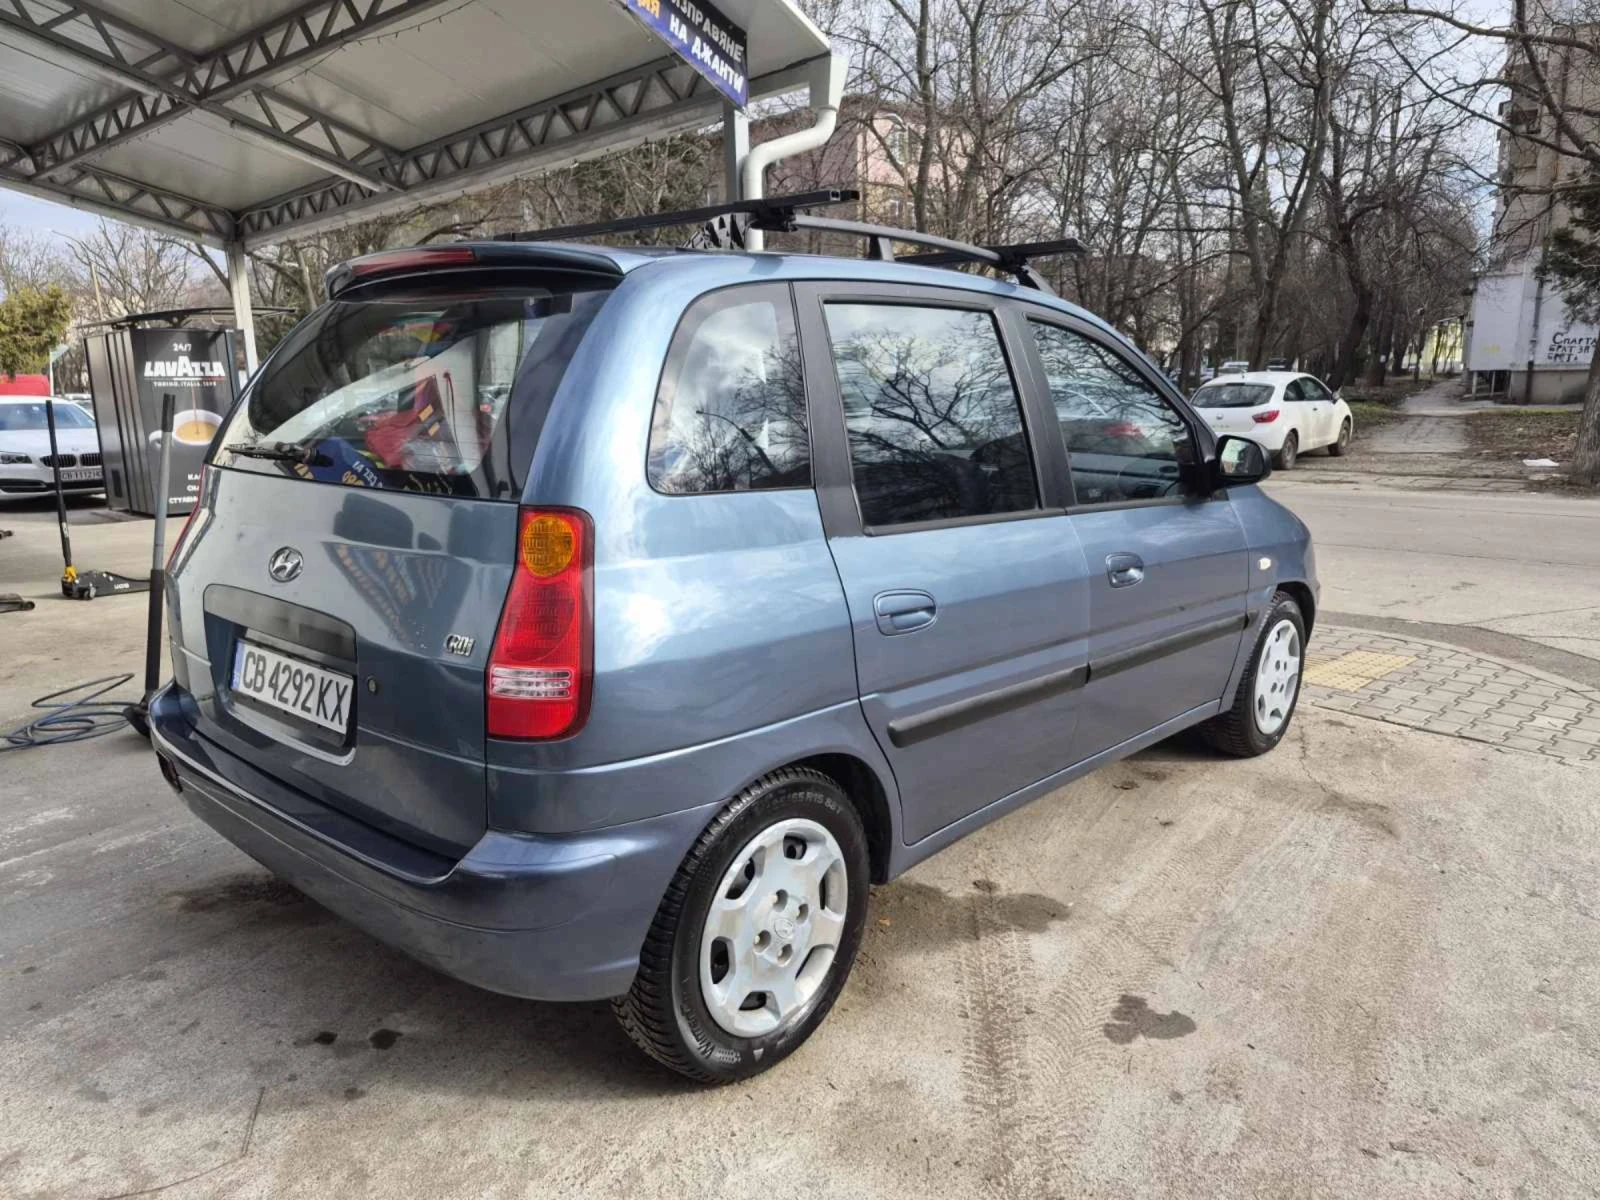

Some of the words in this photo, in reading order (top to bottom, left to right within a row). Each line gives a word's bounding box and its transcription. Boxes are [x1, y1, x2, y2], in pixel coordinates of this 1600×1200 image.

[669, 14, 687, 44] НА
[691, 36, 744, 93] ДЖАНТИ
[173, 343, 192, 352] 24/7
[143, 355, 226, 377] LAVAZZA
